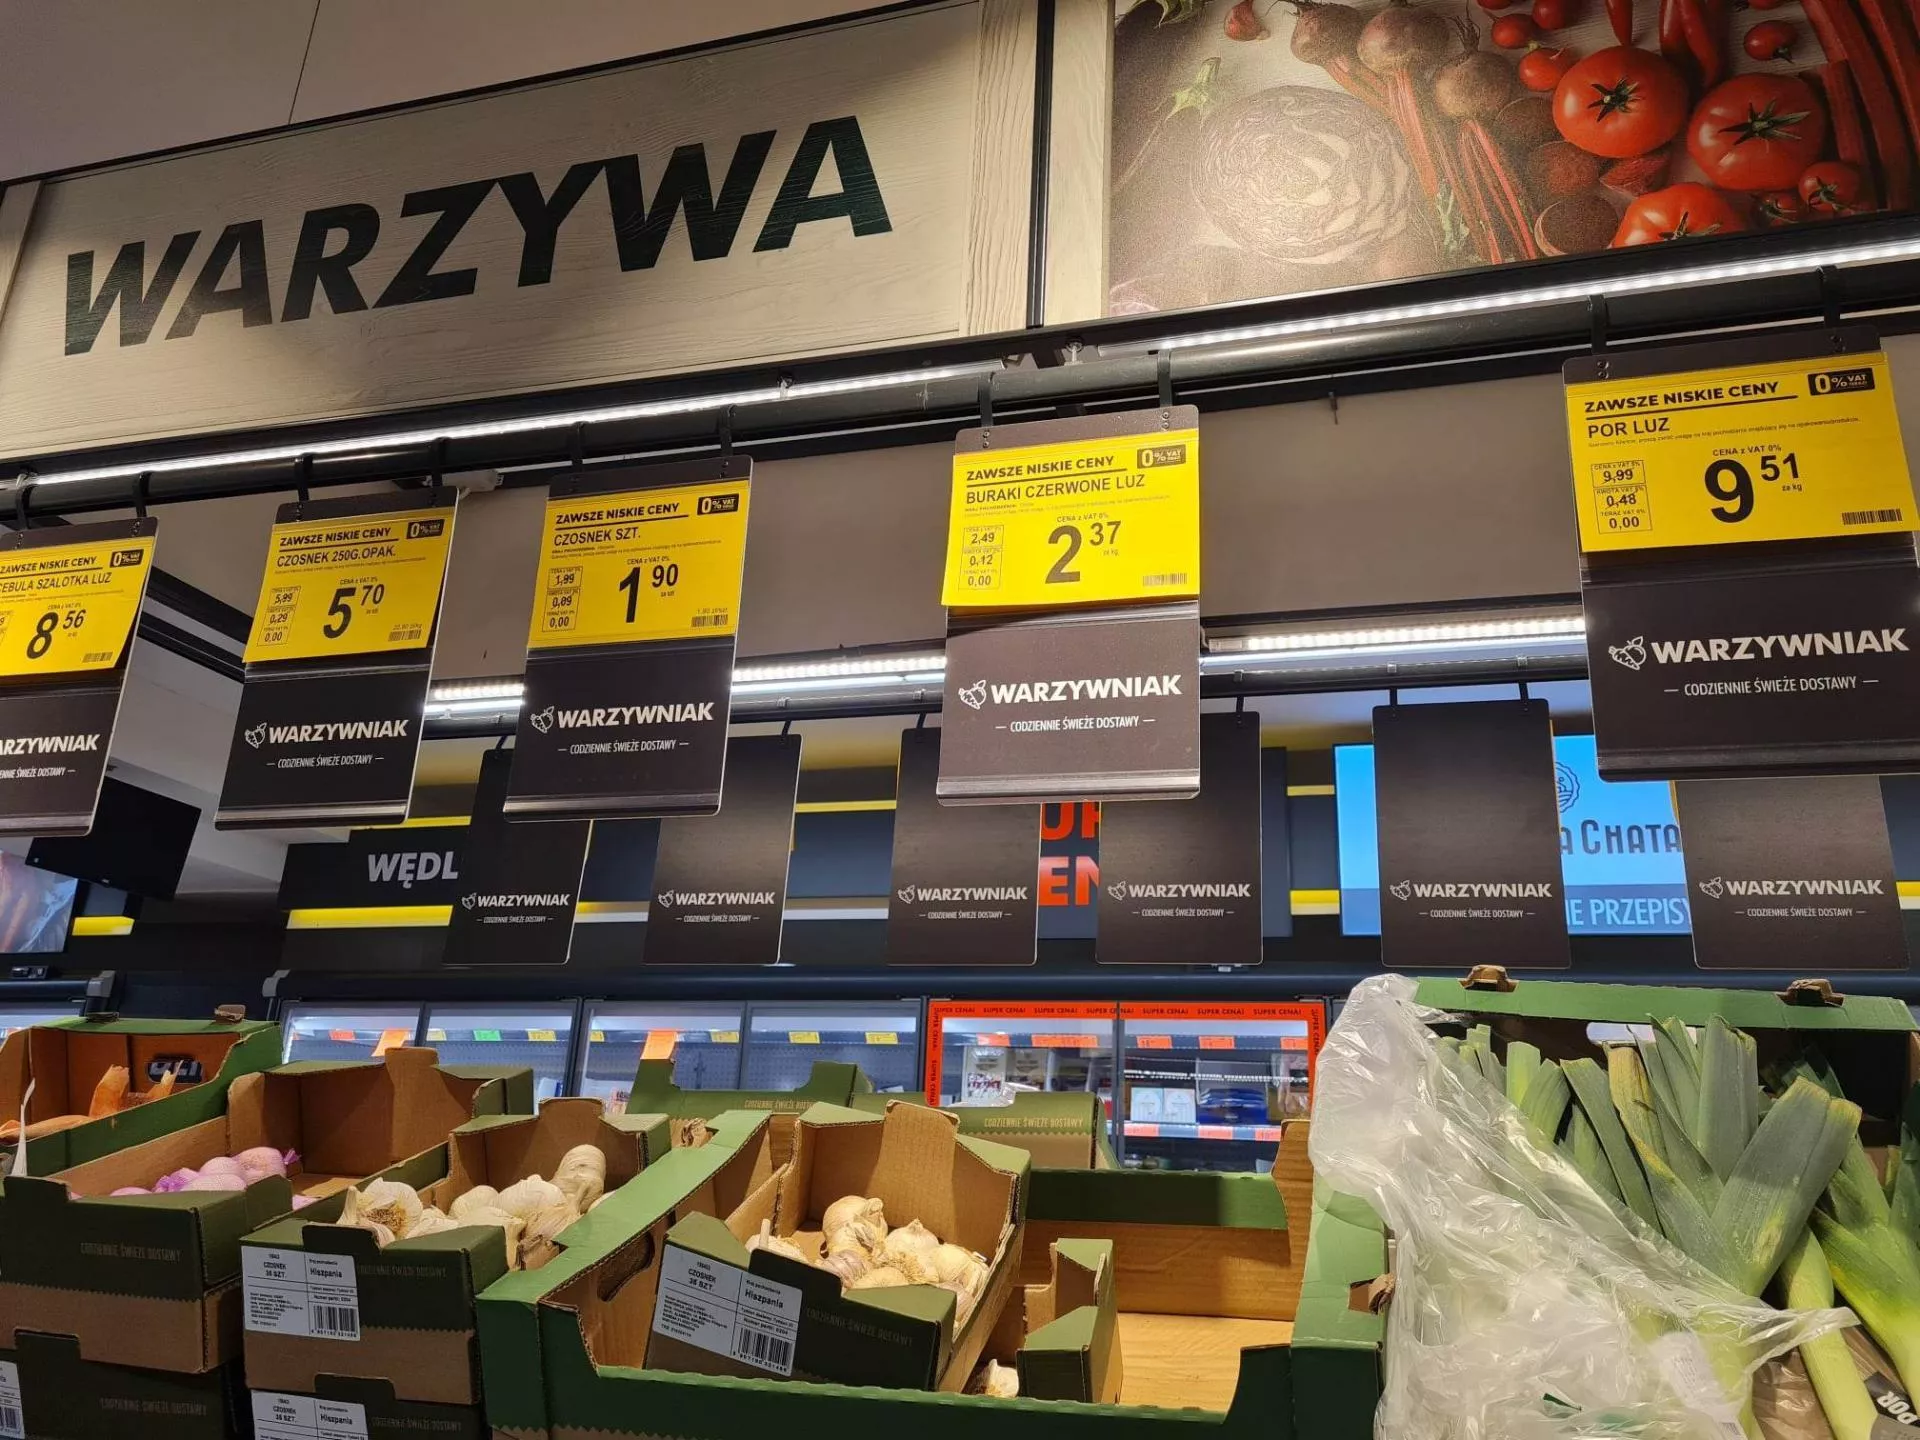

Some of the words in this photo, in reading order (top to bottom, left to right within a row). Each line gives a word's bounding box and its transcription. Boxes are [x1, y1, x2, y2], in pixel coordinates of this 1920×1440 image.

[64, 115, 893, 356] WARZYWA
[1847, 374, 1867, 382] VAT
[1584, 395, 1659, 413] ZAWSZE
[1663, 387, 1723, 404] NISKIE
[1728, 381, 1778, 398] CENY
[1588, 422, 1628, 438] POR
[1633, 417, 1670, 434] LUZ
[1713, 447, 1738, 456] CENA
[1747, 445, 1765, 454] VAT
[967, 466, 1023, 480] ZAWSZE
[1027, 460, 1072, 474] NISKIE
[1076, 456, 1114, 469] CENY
[1603, 468, 1633, 483] 9,99
[966, 487, 1021, 504] BURAKI
[1025, 478, 1111, 499] CZERWONE
[1117, 474, 1145, 489] LUZ
[1704, 459, 1755, 523] 9
[1760, 453, 1799, 482] 51
[1791, 483, 1803, 492] kg
[1606, 493, 1637, 508] 0,48
[556, 511, 603, 524] ZAWSZE
[606, 506, 645, 519] NISKIE
[647, 503, 679, 515] CENY
[1609, 516, 1639, 530] 0,00
[280, 532, 322, 546] ZAWSZE
[326, 530, 360, 541] NISKIE
[362, 527, 391, 538] CENY
[554, 529, 612, 546] CZOSNEK
[616, 527, 641, 540] SZT.
[971, 532, 995, 545] 2,49
[277, 551, 329, 567] CZOSNEK
[332, 545, 396, 562] 250G.OPAK.
[1045, 525, 1082, 584] 2
[1089, 520, 1122, 546] 37
[0, 562, 37, 574] ZAWSZE
[39, 560, 69, 570] NISKIE
[71, 556, 97, 566] CENY
[36, 574, 89, 590] SZALOTKA
[92, 572, 112, 583] LUZ
[968, 575, 991, 587] 0,00
[619, 566, 641, 623] 1
[652, 564, 679, 588] 90
[323, 587, 356, 639] 5
[361, 584, 385, 606] 70
[550, 616, 569, 628] 0,00
[27, 612, 59, 659] 8
[62, 609, 87, 630] 56
[265, 632, 283, 641] 0,00
[1651, 628, 1910, 664] WARZYWNIAK
[991, 674, 1183, 704] WARZYWNIAK
[1684, 680, 1751, 696] CODZIENNIE
[1754, 676, 1797, 694] ŚWIEŻE
[1800, 676, 1857, 691] DOSTAWY
[557, 702, 715, 728] WARZYWNIAK
[1010, 719, 1061, 733] CODZIENNIE
[1063, 714, 1095, 730] ŚWIEŻE
[1097, 715, 1139, 729] DOSTAWY
[269, 719, 409, 744] WARZYWNIAK
[570, 742, 611, 755] CODZIENNIE
[613, 739, 639, 752] ŚWIEŻE
[641, 739, 676, 751] DOSTAWY
[277, 757, 315, 768] CODZIENNIE
[316, 754, 339, 766] ŚWIEŻE
[341, 755, 373, 766] DOSTAWY
[37, 766, 66, 777] DOSTAWY
[917, 887, 1028, 901] WARZYWNIAK
[1129, 884, 1251, 898] WARZYWNIAK
[1413, 883, 1552, 898] WARZYWNIAK
[1726, 879, 1884, 895] WARZYWNIAK
[477, 893, 570, 908] WARZYWNIAK
[675, 892, 775, 905] WARZYWNIAK
[1197, 908, 1224, 917] DOSTAWY
[1430, 909, 1467, 918] CODZIENNIE
[1492, 909, 1523, 918] DOSTAWY
[1747, 908, 1789, 916] CODZIENNIE
[1818, 907, 1853, 916] DOSTAWY
[310, 1268, 342, 1278] Hiszpania
[745, 1289, 784, 1309] Hiszpania
[1877, 1391, 1918, 1425] POR
[320, 1414, 353, 1425] Hiszpania
